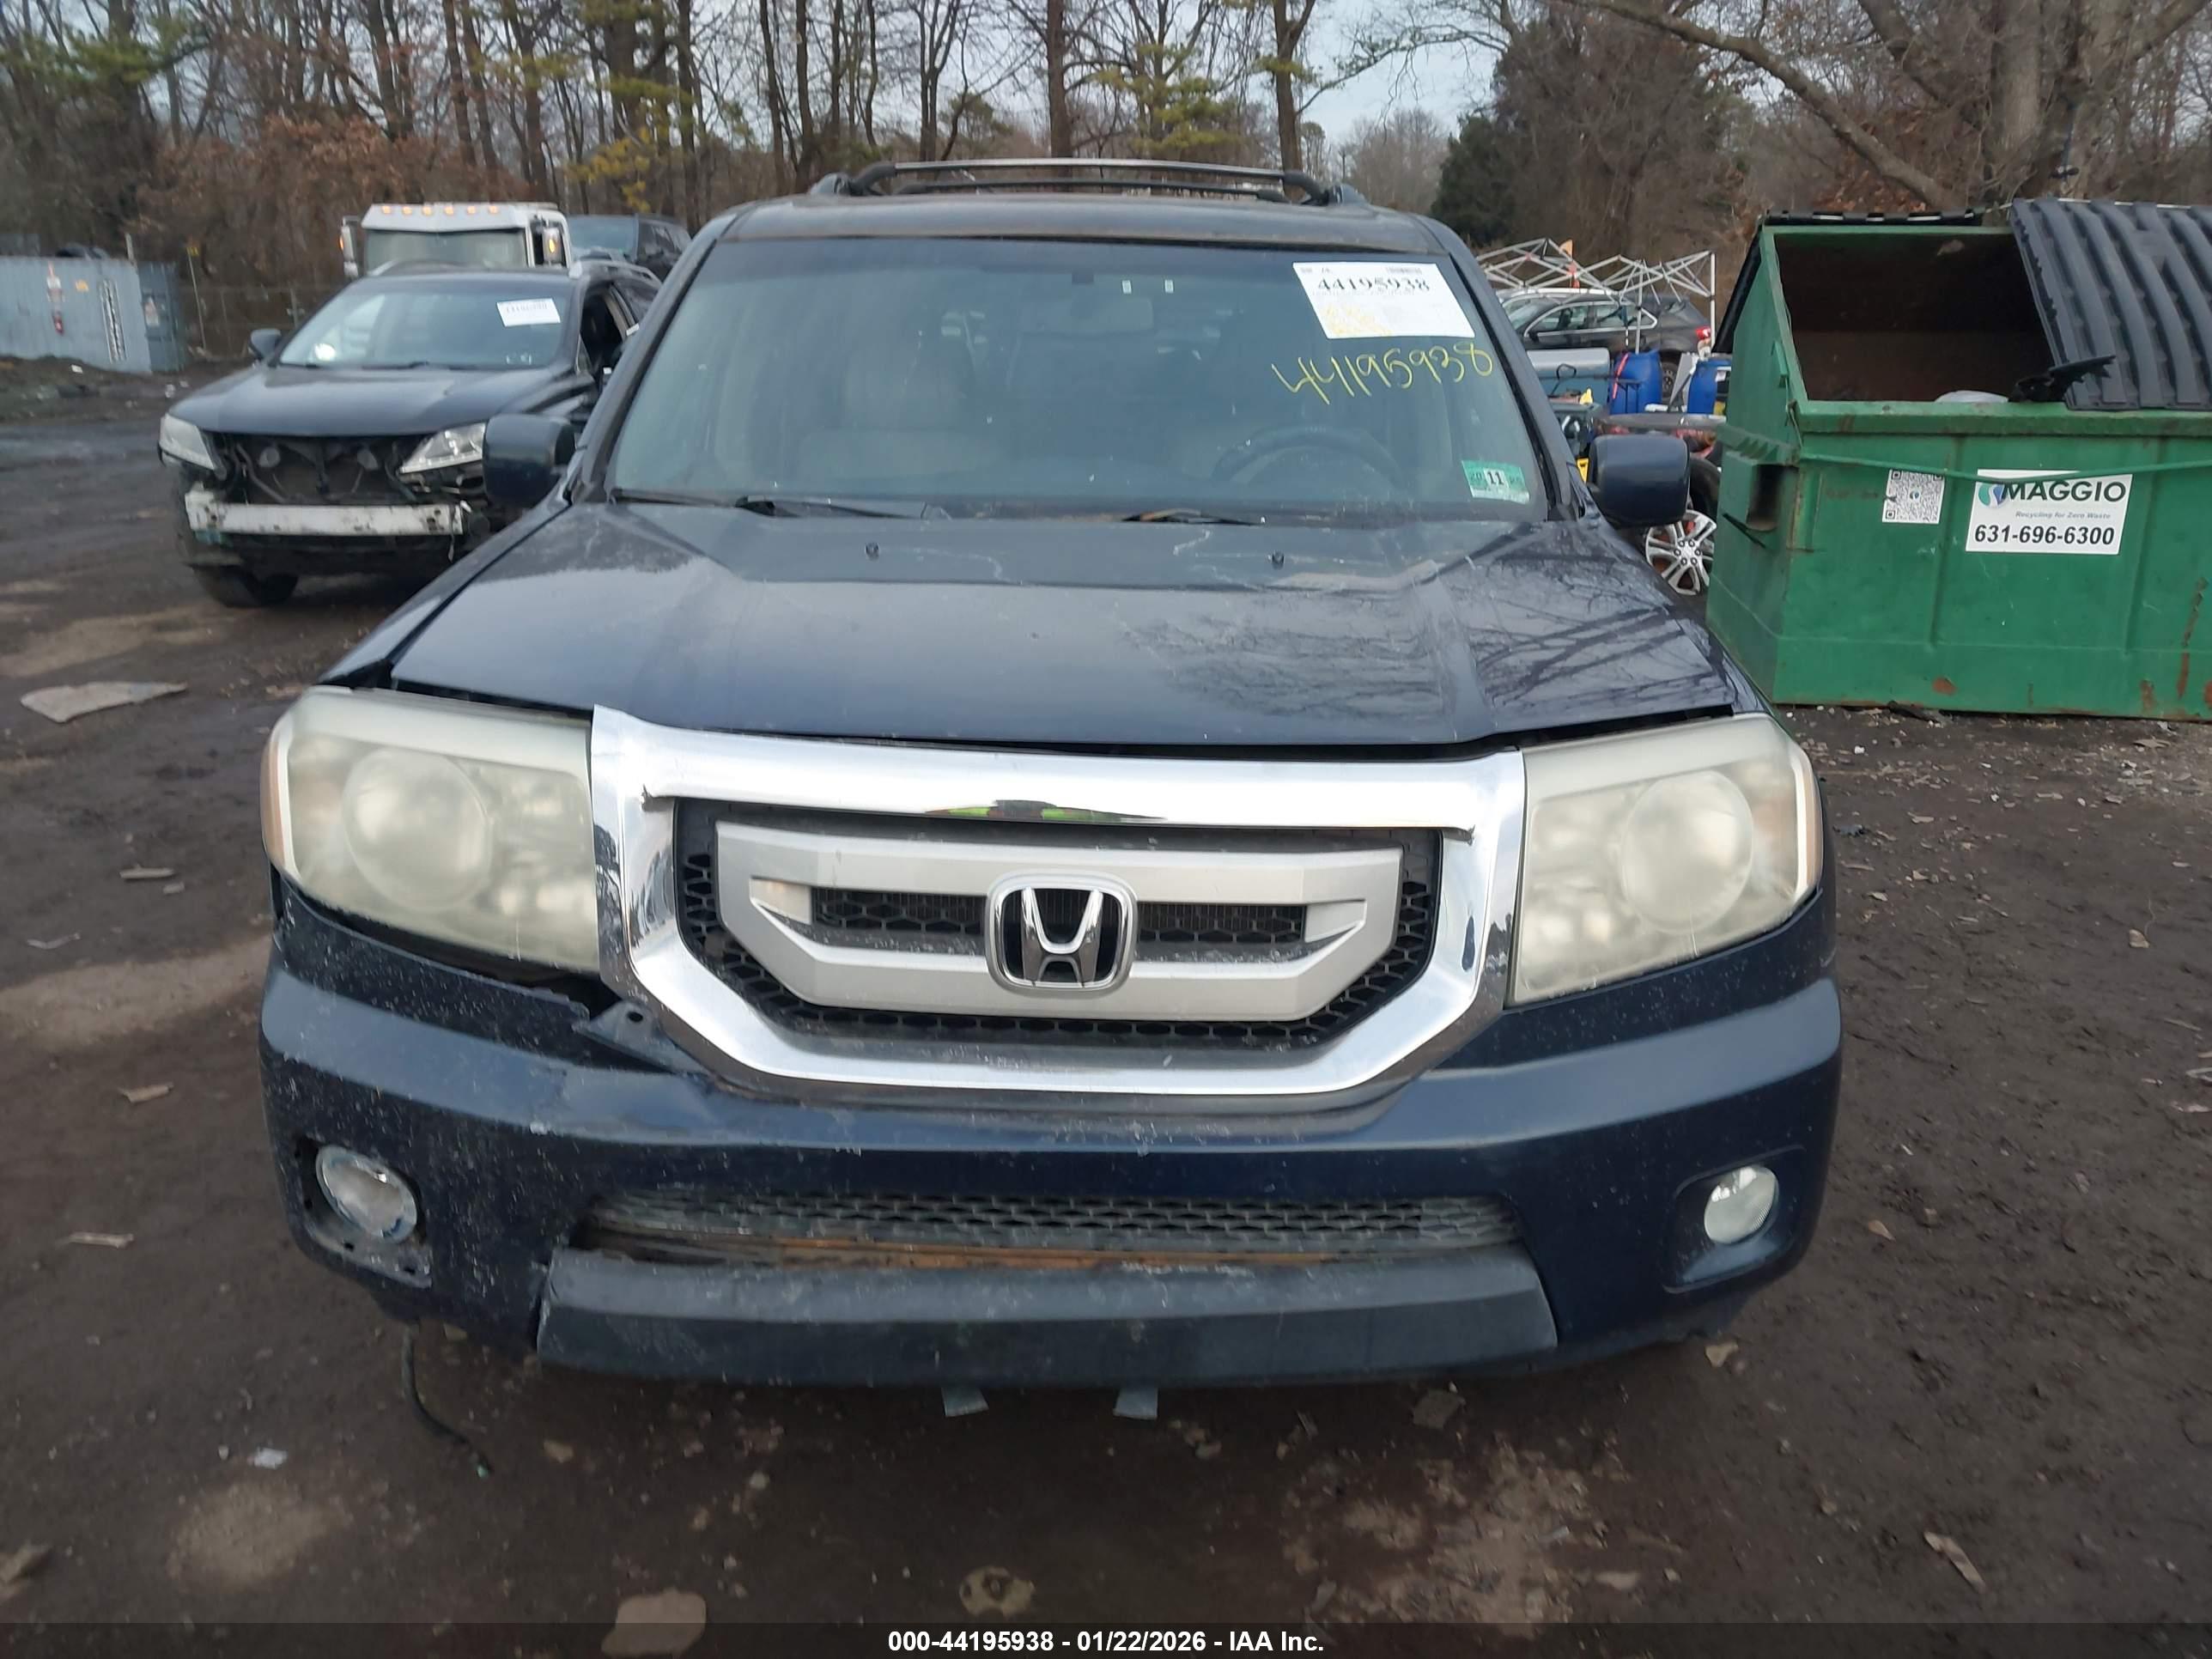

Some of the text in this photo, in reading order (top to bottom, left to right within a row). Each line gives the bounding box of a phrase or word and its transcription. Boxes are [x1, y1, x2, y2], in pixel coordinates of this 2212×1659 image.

[1318, 277, 1430, 292] 44195938
[1271, 343, 1493, 405] 44195938
[1486, 471, 1504, 485] 11
[2001, 480, 2126, 502] MAGGIO
[2055, 510, 2065, 519] for
[1974, 524, 2115, 545] 631-696-6300
